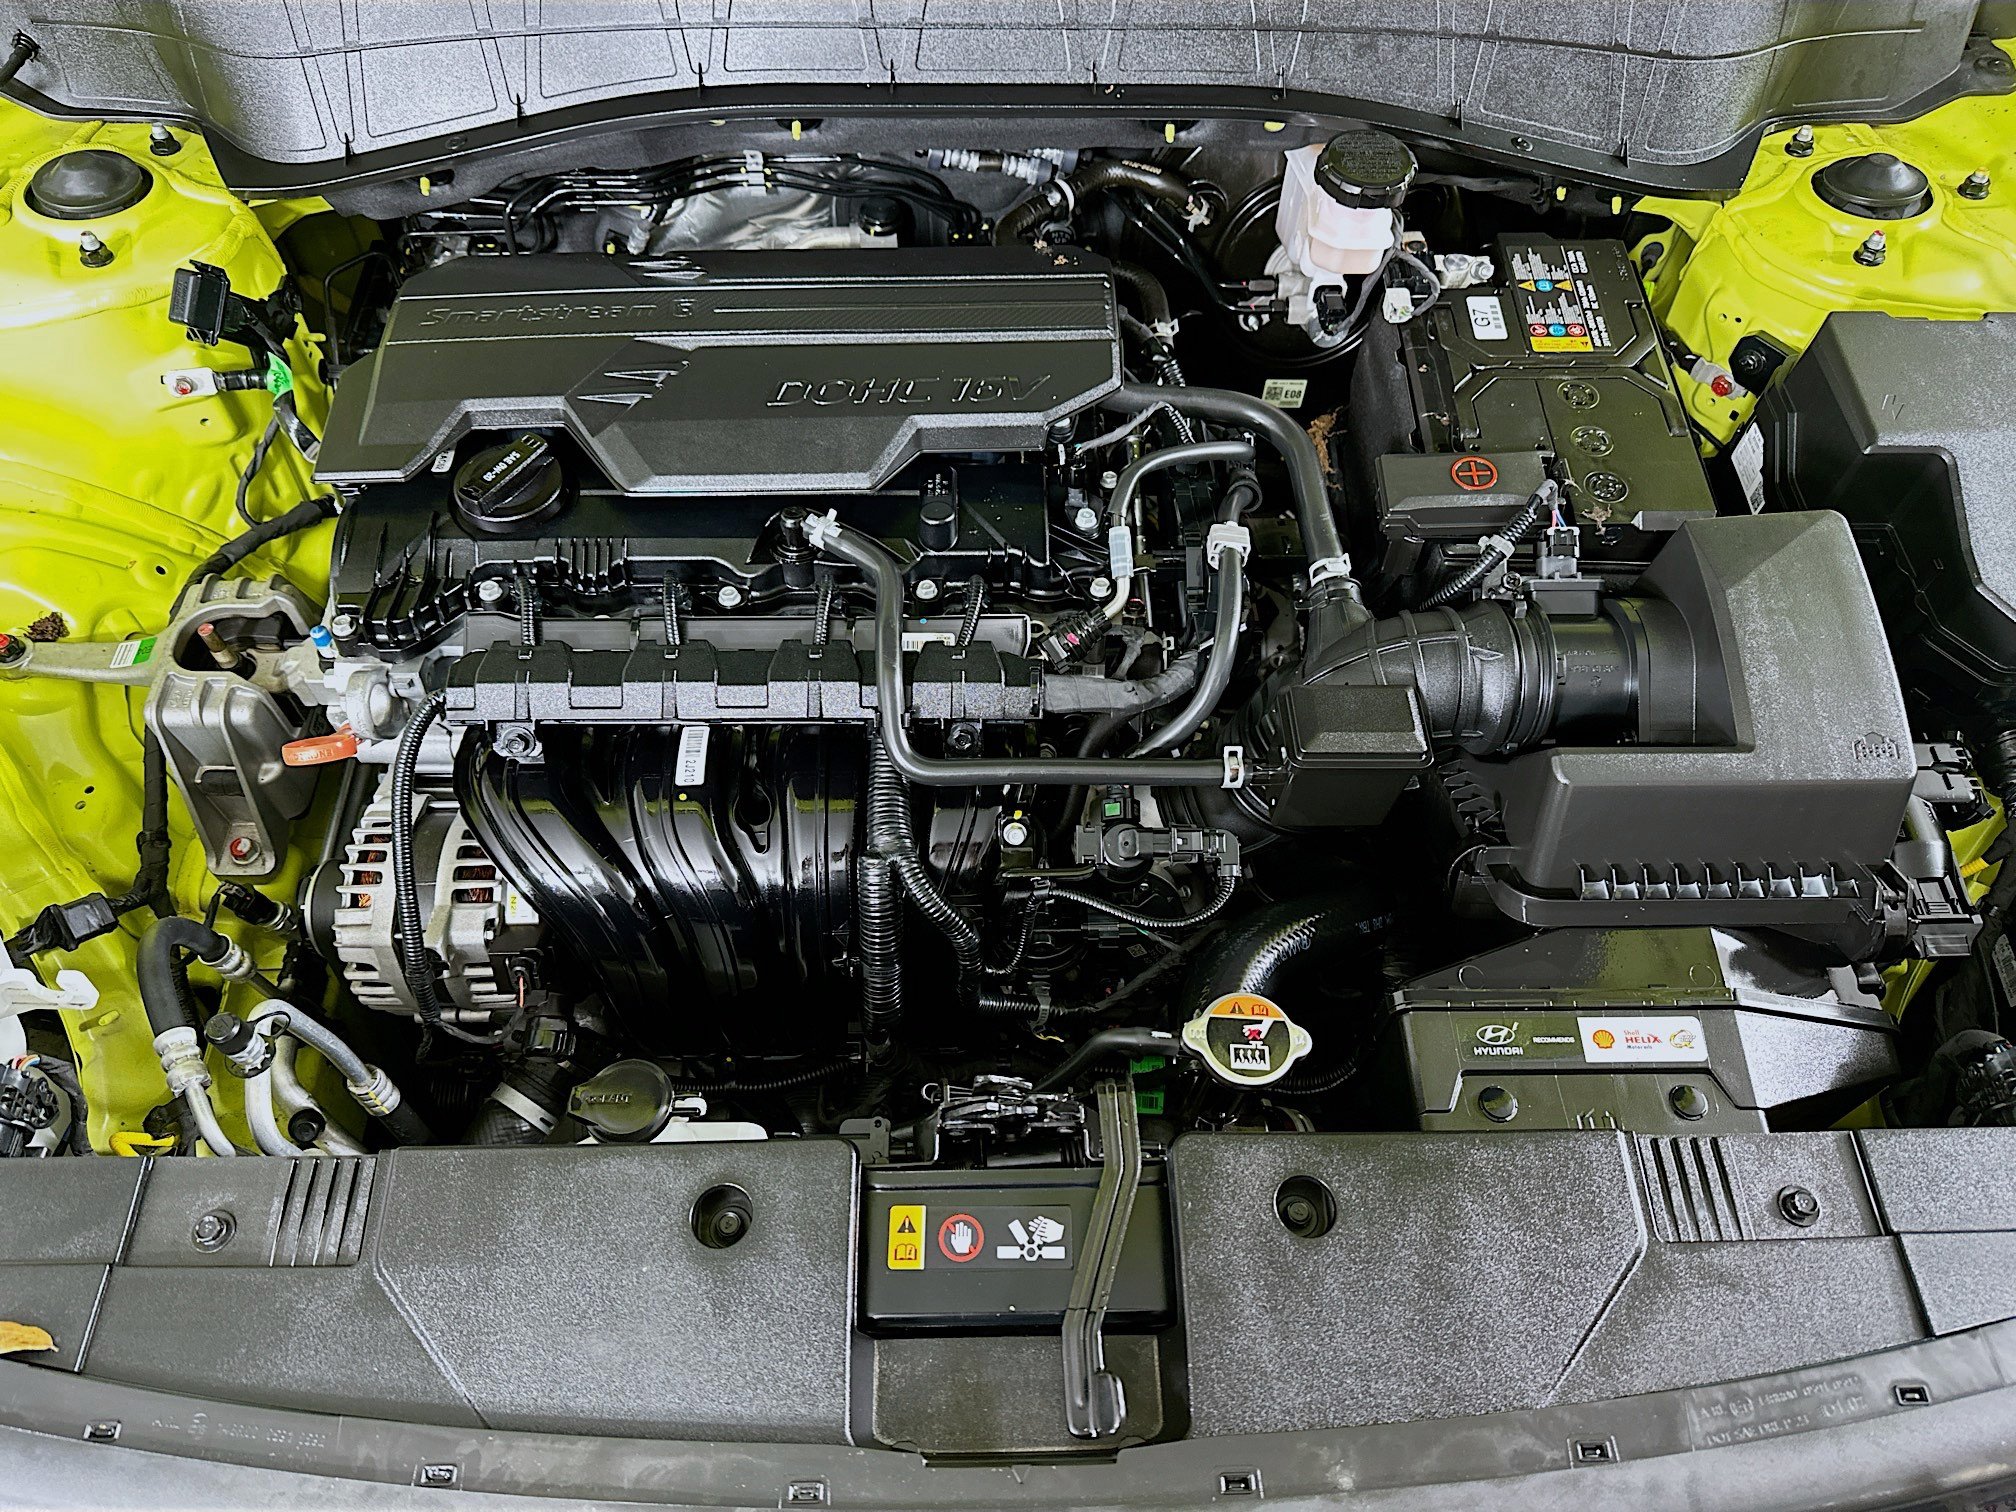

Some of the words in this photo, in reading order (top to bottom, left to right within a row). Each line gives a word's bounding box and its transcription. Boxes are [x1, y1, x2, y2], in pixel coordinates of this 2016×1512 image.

[418, 304, 657, 326] Smartstream
[1472, 309, 1490, 326] G7
[767, 378, 939, 405] DOHC
[951, 375, 1050, 402] 16V
[503, 450, 521, 465] SAE
[482, 463, 507, 482] 0W-20
[684, 760, 697, 783] 2J210
[1474, 1046, 1524, 1056] HYUNDAI
[1625, 1035, 1662, 1043] HELIX
